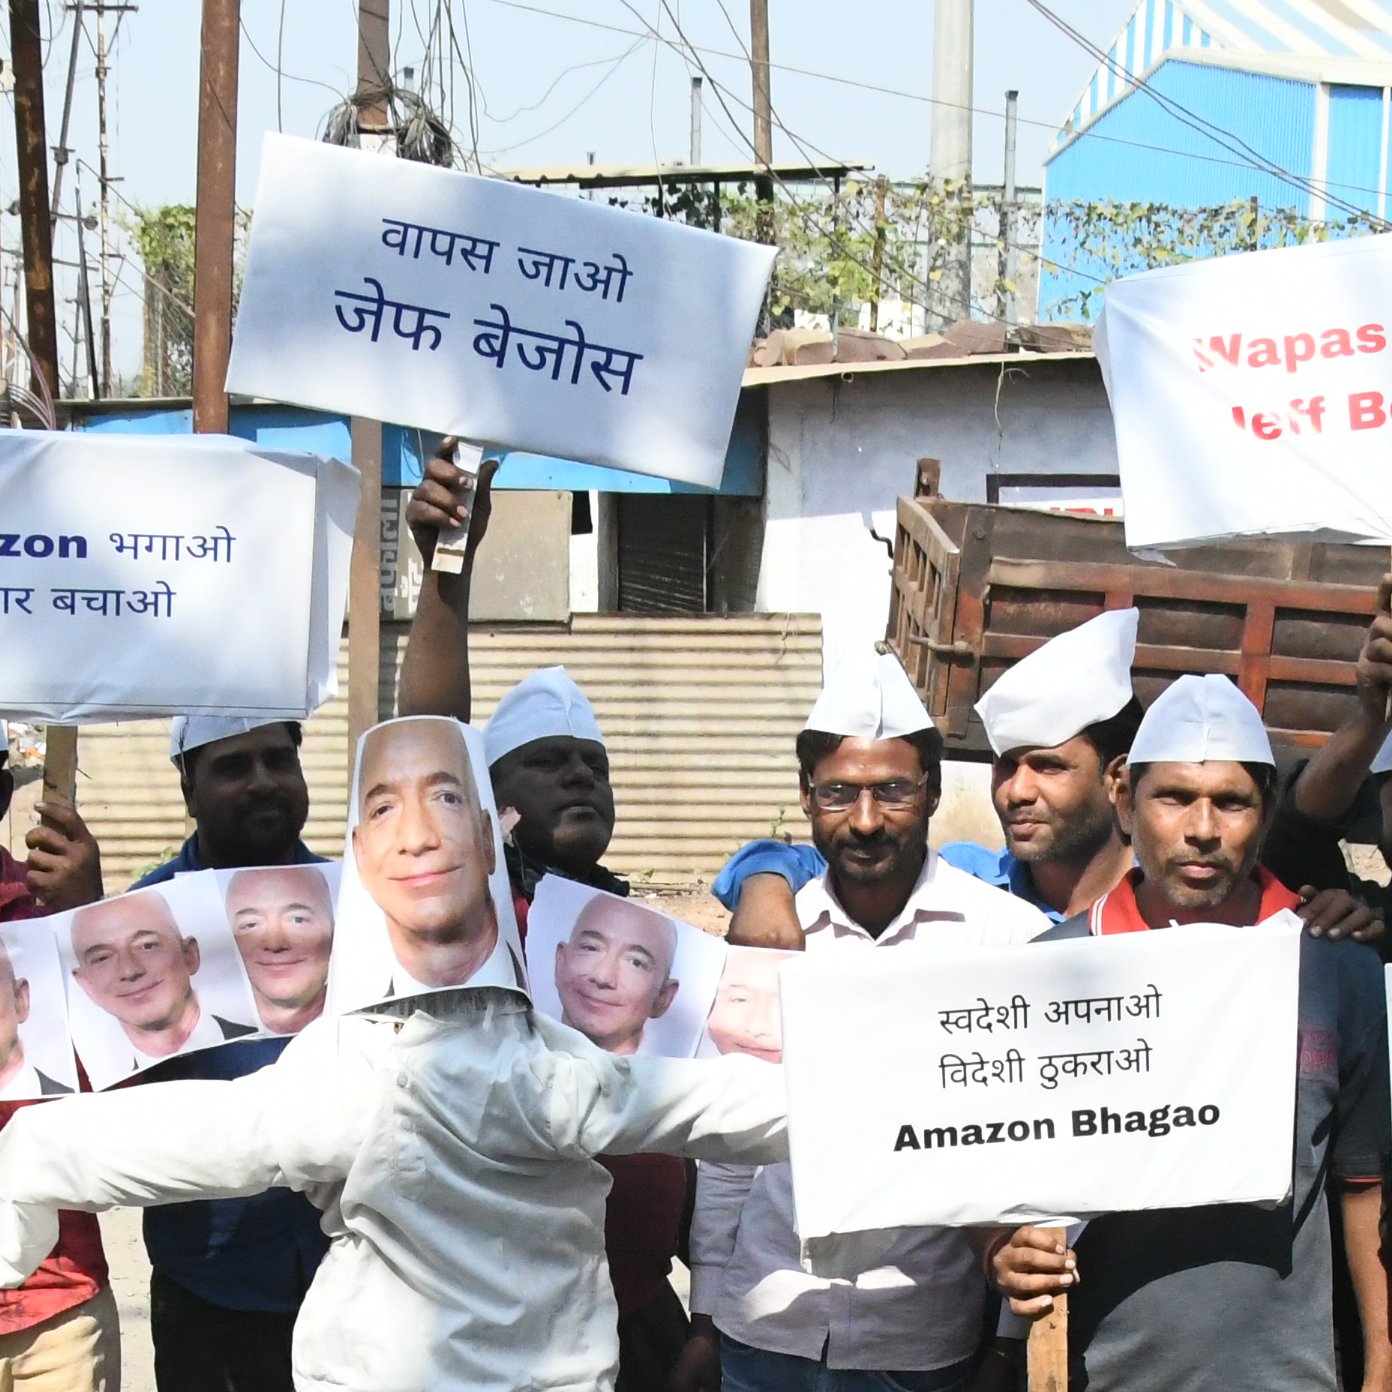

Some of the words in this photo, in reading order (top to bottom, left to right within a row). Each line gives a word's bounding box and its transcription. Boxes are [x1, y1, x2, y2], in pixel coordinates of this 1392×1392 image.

[381, 218, 500, 274] वापस
[517, 246, 633, 302] जाओ
[334, 277, 450, 352] जेफ
[473, 303, 644, 396] बेजोस
[1193, 323, 1386, 373] Wapas
[109, 526, 236, 563] भगाओ
[51, 580, 176, 618] बचाओ
[938, 995, 1029, 1036] स्वदेशी
[1044, 984, 1163, 1026] अपनाओ
[939, 1048, 1026, 1088] विदेशी
[1038, 1038, 1152, 1090] ठुकराओ
[893, 1110, 1055, 1152] Amazon
[1071, 1102, 1221, 1139] Bhagao
